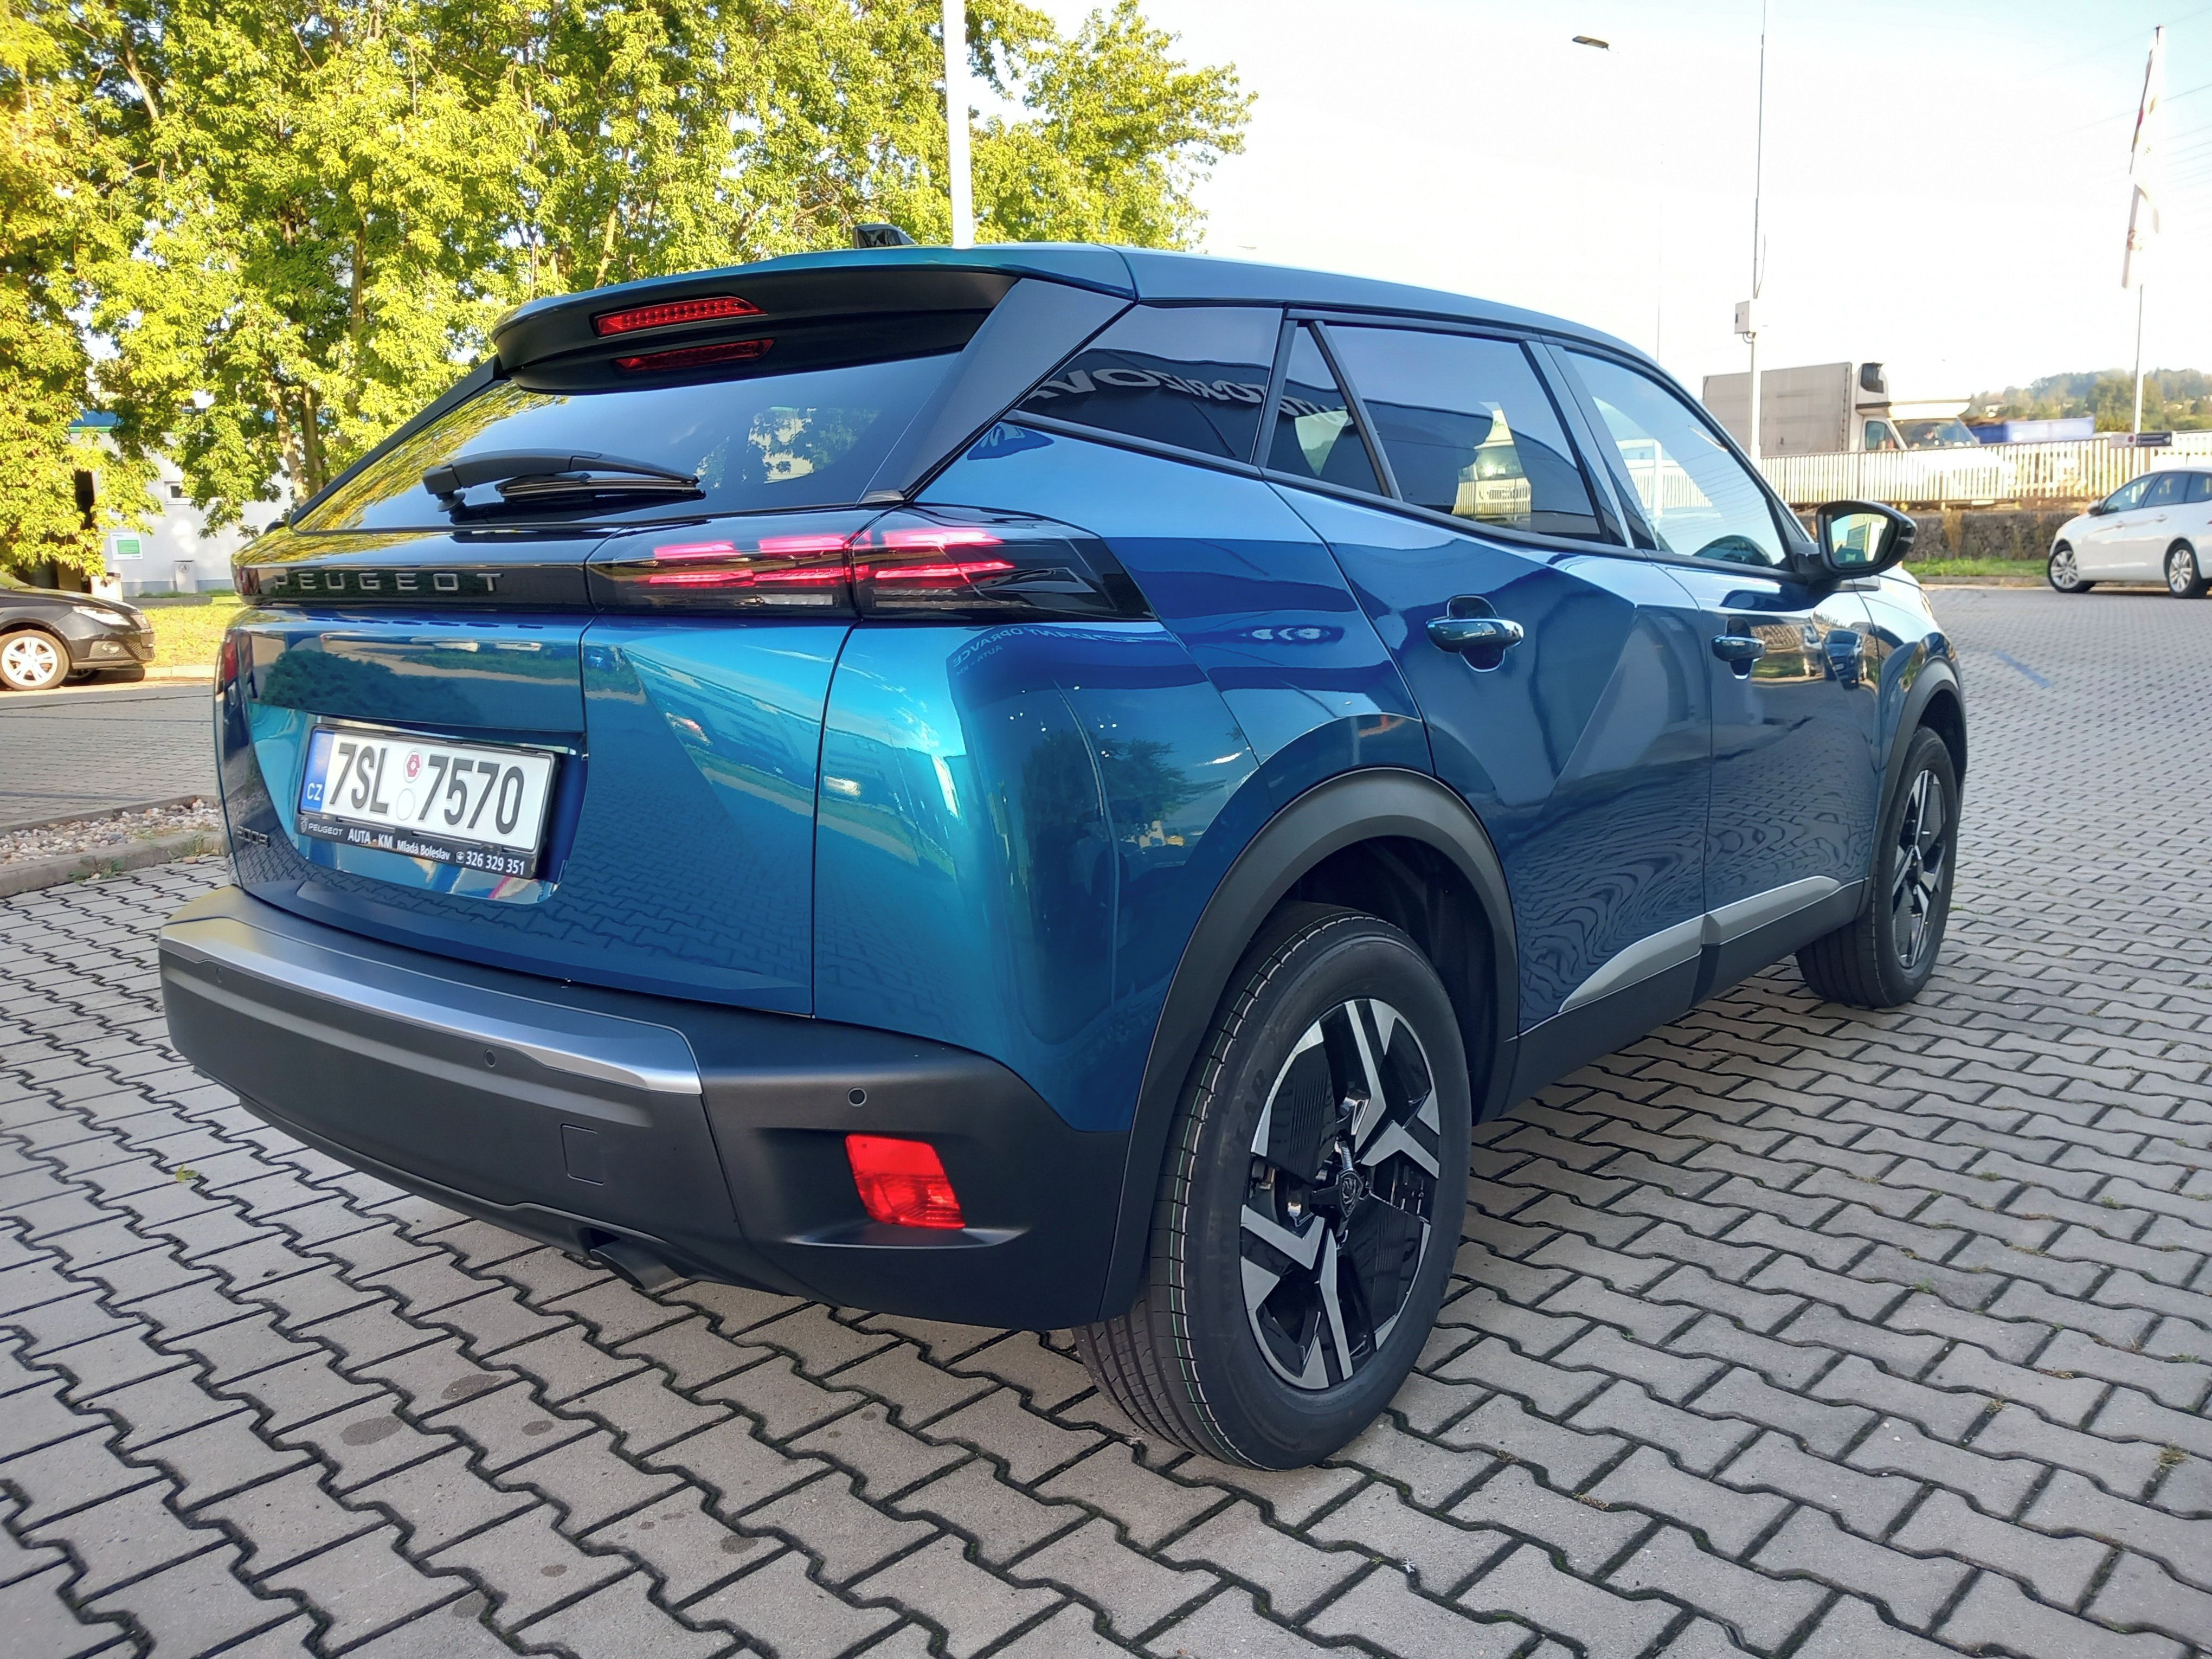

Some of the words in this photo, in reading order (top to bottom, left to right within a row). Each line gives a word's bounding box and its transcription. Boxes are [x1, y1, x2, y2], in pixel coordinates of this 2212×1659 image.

[273, 572, 504, 591] PEUGEOT
[306, 782, 323, 802] CZ
[329, 742, 389, 814] 7SL
[418, 754, 524, 835] 7570
[308, 822, 344, 836] PEUGEOT
[347, 828, 371, 845] AUTA
[378, 833, 394, 850] KM
[396, 839, 419, 855] Mladá
[420, 845, 451, 860] Boleslav
[465, 851, 484, 867] 326
[485, 854, 504, 871] 329
[505, 858, 525, 876] 351
